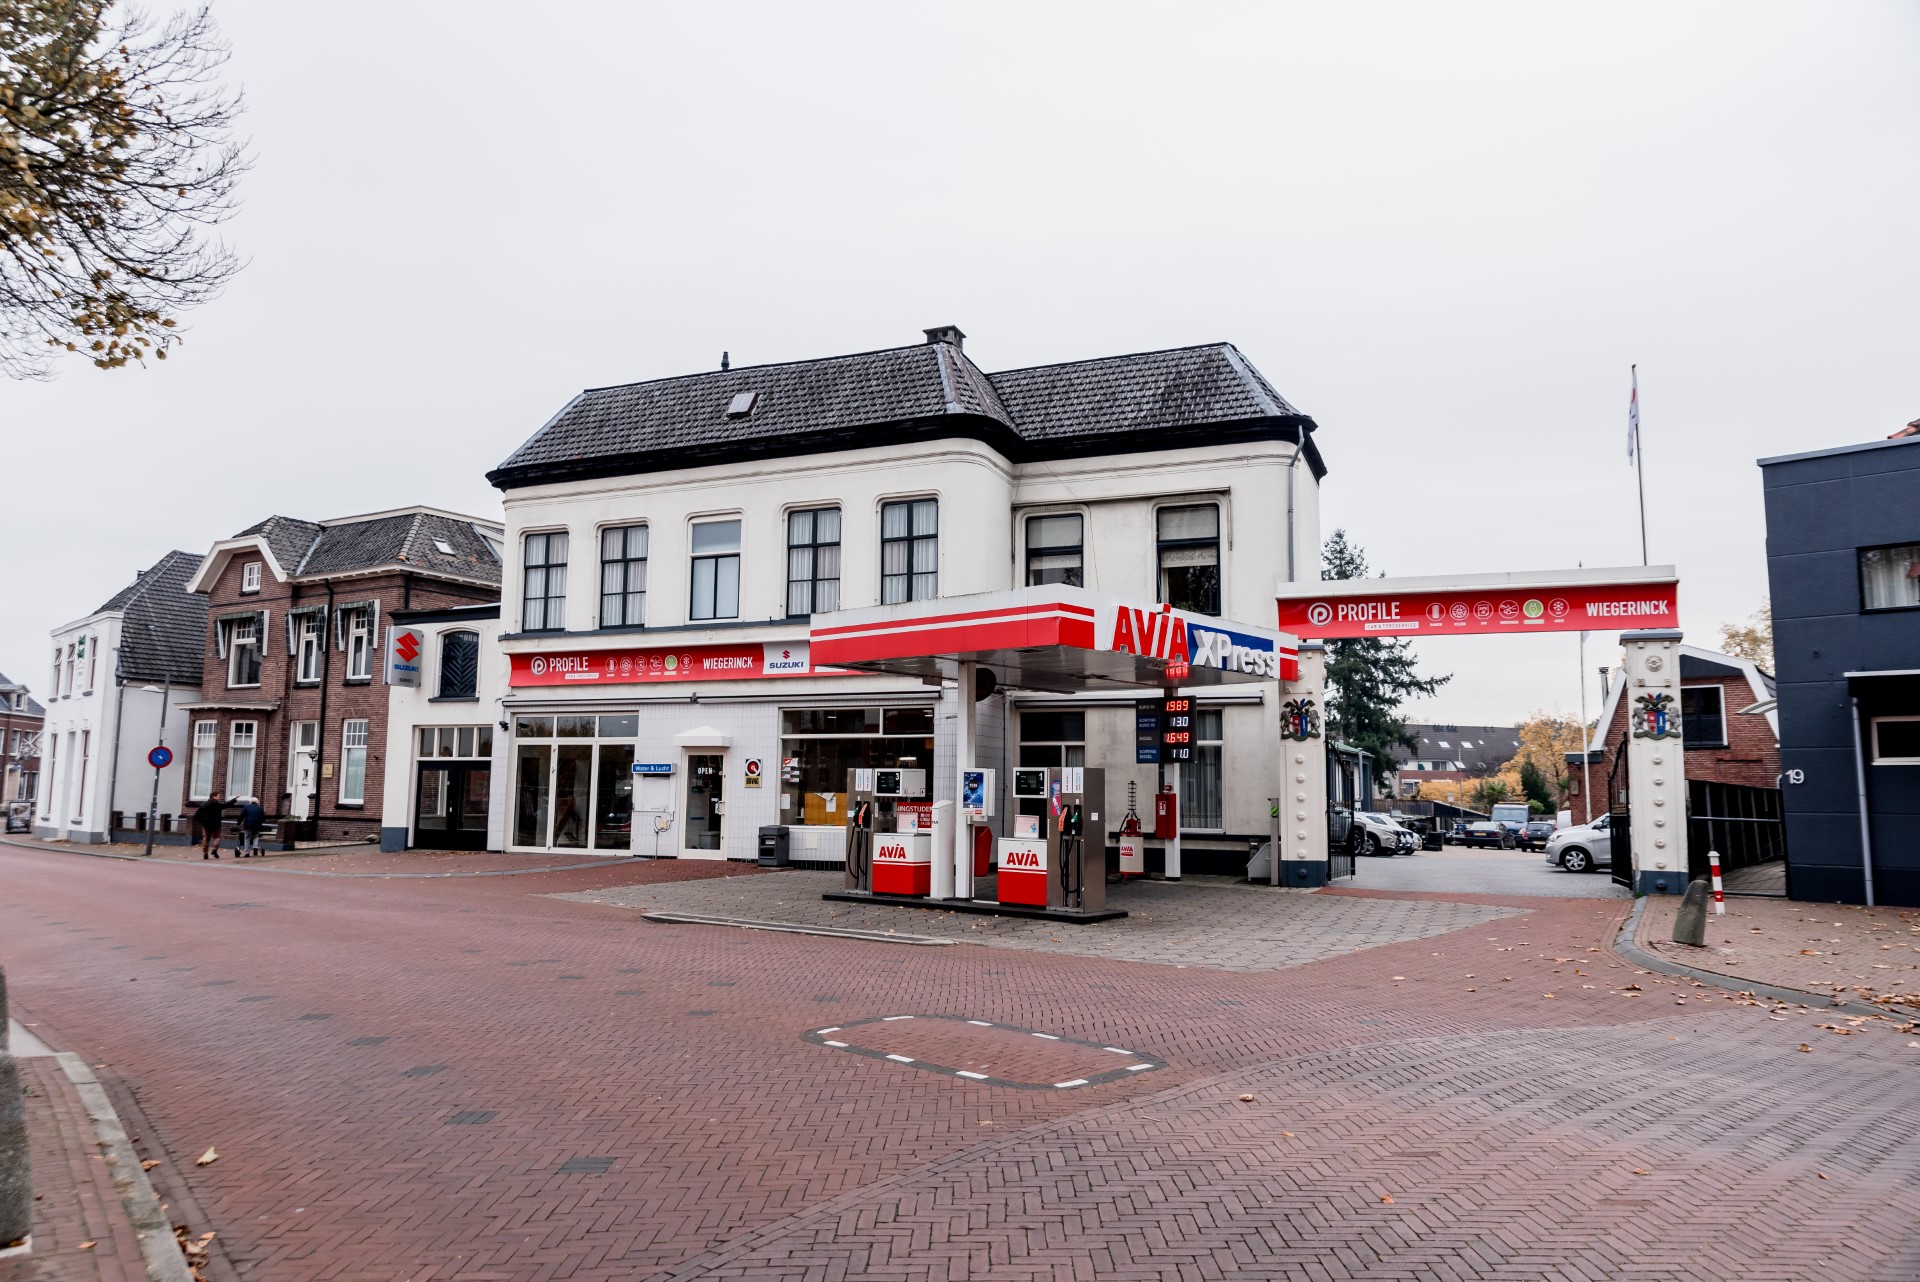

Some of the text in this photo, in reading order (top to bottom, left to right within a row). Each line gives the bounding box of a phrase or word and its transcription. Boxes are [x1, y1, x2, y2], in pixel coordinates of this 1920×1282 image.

[1338, 600, 1669, 621] PROFILE WIEGERINCK
[394, 663, 419, 672] SUZUKI
[549, 656, 753, 672] PROFILE WIEGERINCK
[769, 661, 804, 669] SUZUKI
[1165, 700, 1189, 711] 1.989
[1166, 732, 1189, 743] 1.649
[697, 767, 713, 775] OPEN
[895, 772, 900, 780] 3
[1038, 773, 1043, 781] 1
[1784, 769, 1805, 784] 19
